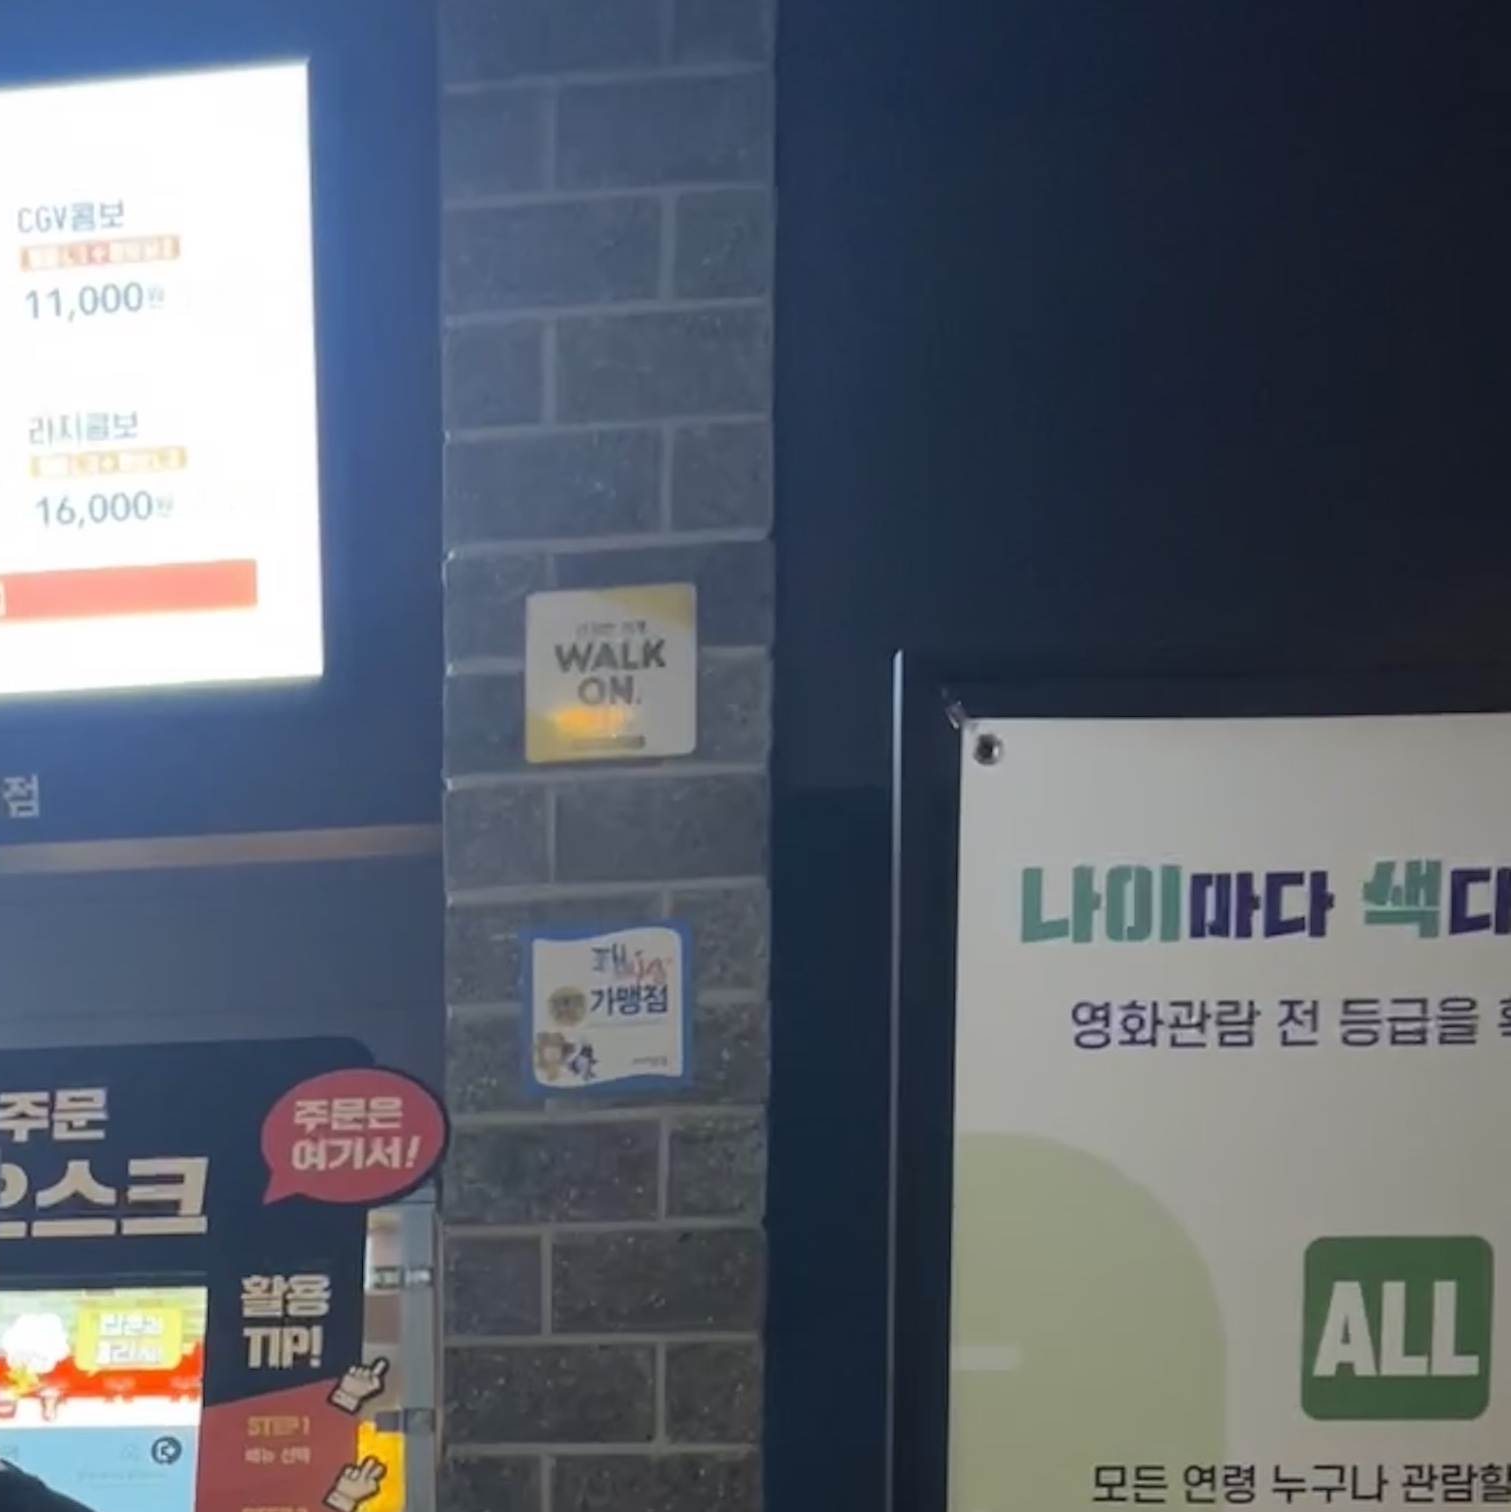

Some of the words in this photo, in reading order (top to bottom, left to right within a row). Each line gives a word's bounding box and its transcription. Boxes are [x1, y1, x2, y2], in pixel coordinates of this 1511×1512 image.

[17, 199, 125, 234] CGV콤보
[553, 638, 667, 674] WALK
[1019, 863, 1335, 944] 나이마다
[590, 984, 669, 1018] 가맹점
[1070, 999, 1262, 1050] 영화관람
[1277, 999, 1320, 1048] 전
[1338, 996, 1481, 1048] 등급을
[292, 1096, 404, 1133] 주문은
[291, 1136, 422, 1172] 여기서!
[240, 1274, 332, 1320] 활용
[242, 1326, 324, 1370] TIP!
[1311, 1279, 1481, 1378] ALL
[247, 1416, 299, 1437] STEP
[1091, 1464, 1169, 1505] 모든
[1183, 1464, 1258, 1505] 연령
[1271, 1464, 1390, 1504] 누구나
